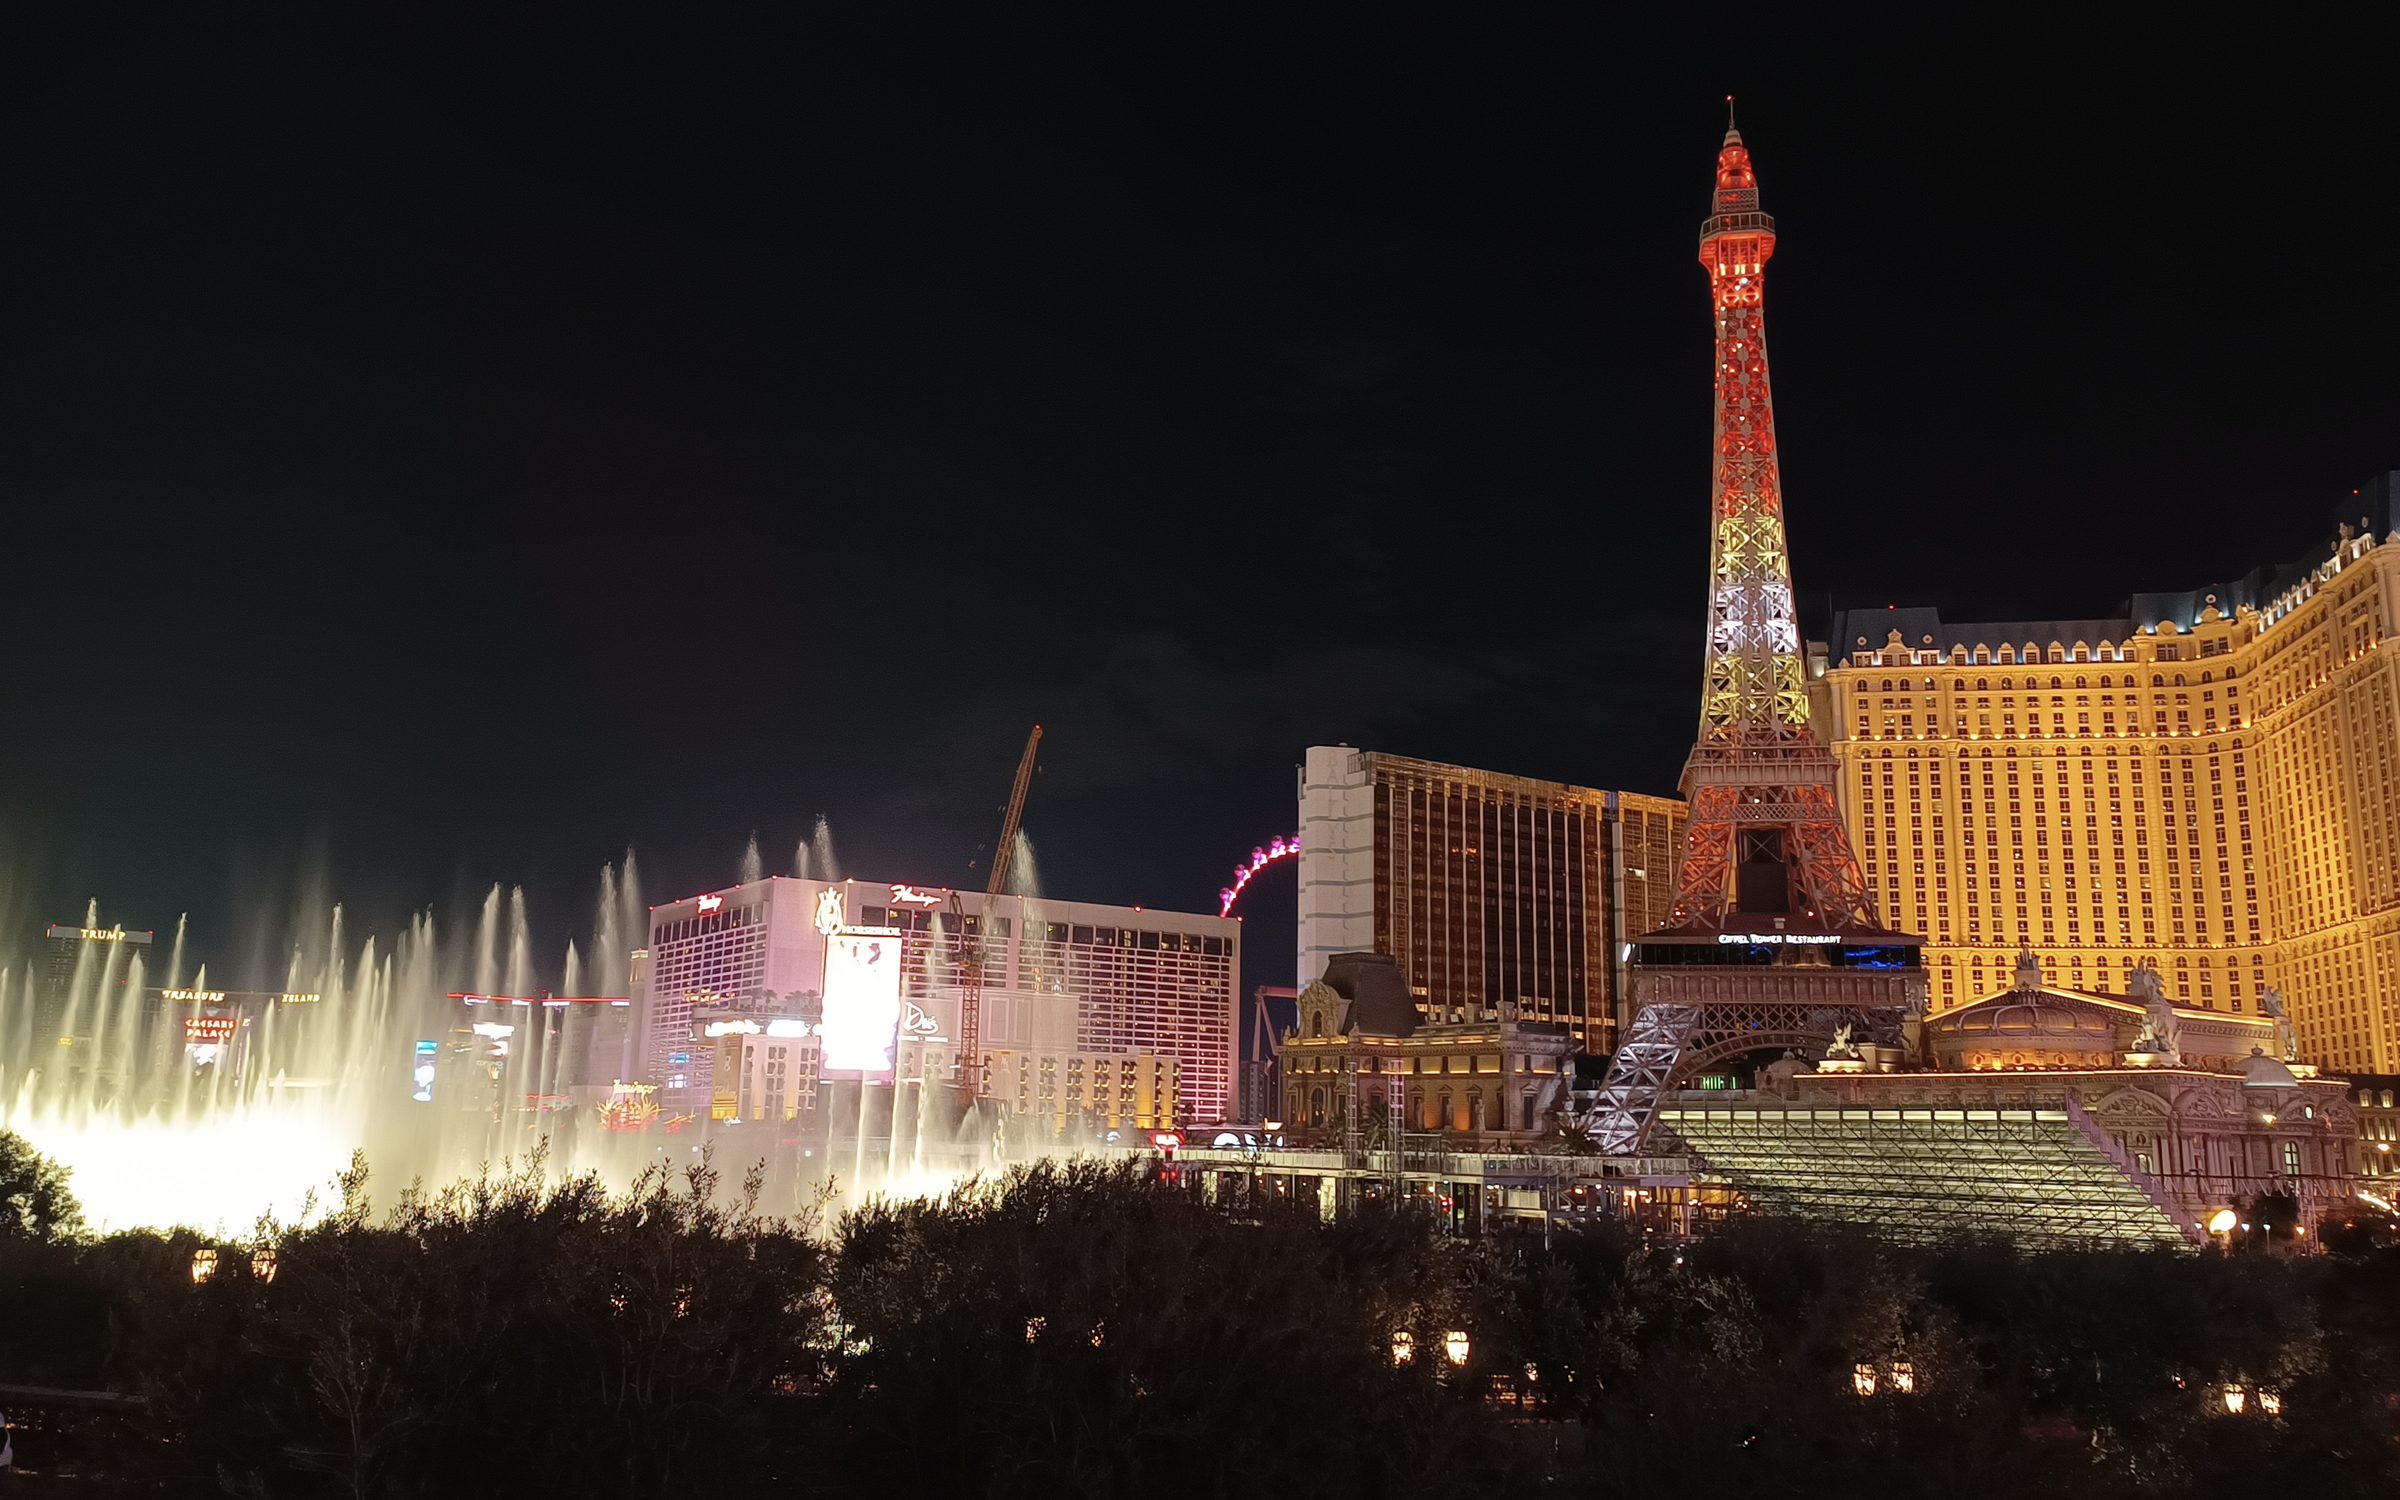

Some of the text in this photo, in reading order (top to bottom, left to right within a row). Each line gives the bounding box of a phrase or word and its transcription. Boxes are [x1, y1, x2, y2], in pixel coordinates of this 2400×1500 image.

[80, 928, 126, 941] TRUMP
[1750, 934, 1782, 944] TOWER
[1786, 934, 1841, 944] RESTAURANT
[162, 990, 320, 1003] TREASURE ISLAND
[185, 1019, 234, 1029] CAESARS
[186, 1028, 231, 1038] PALACE
